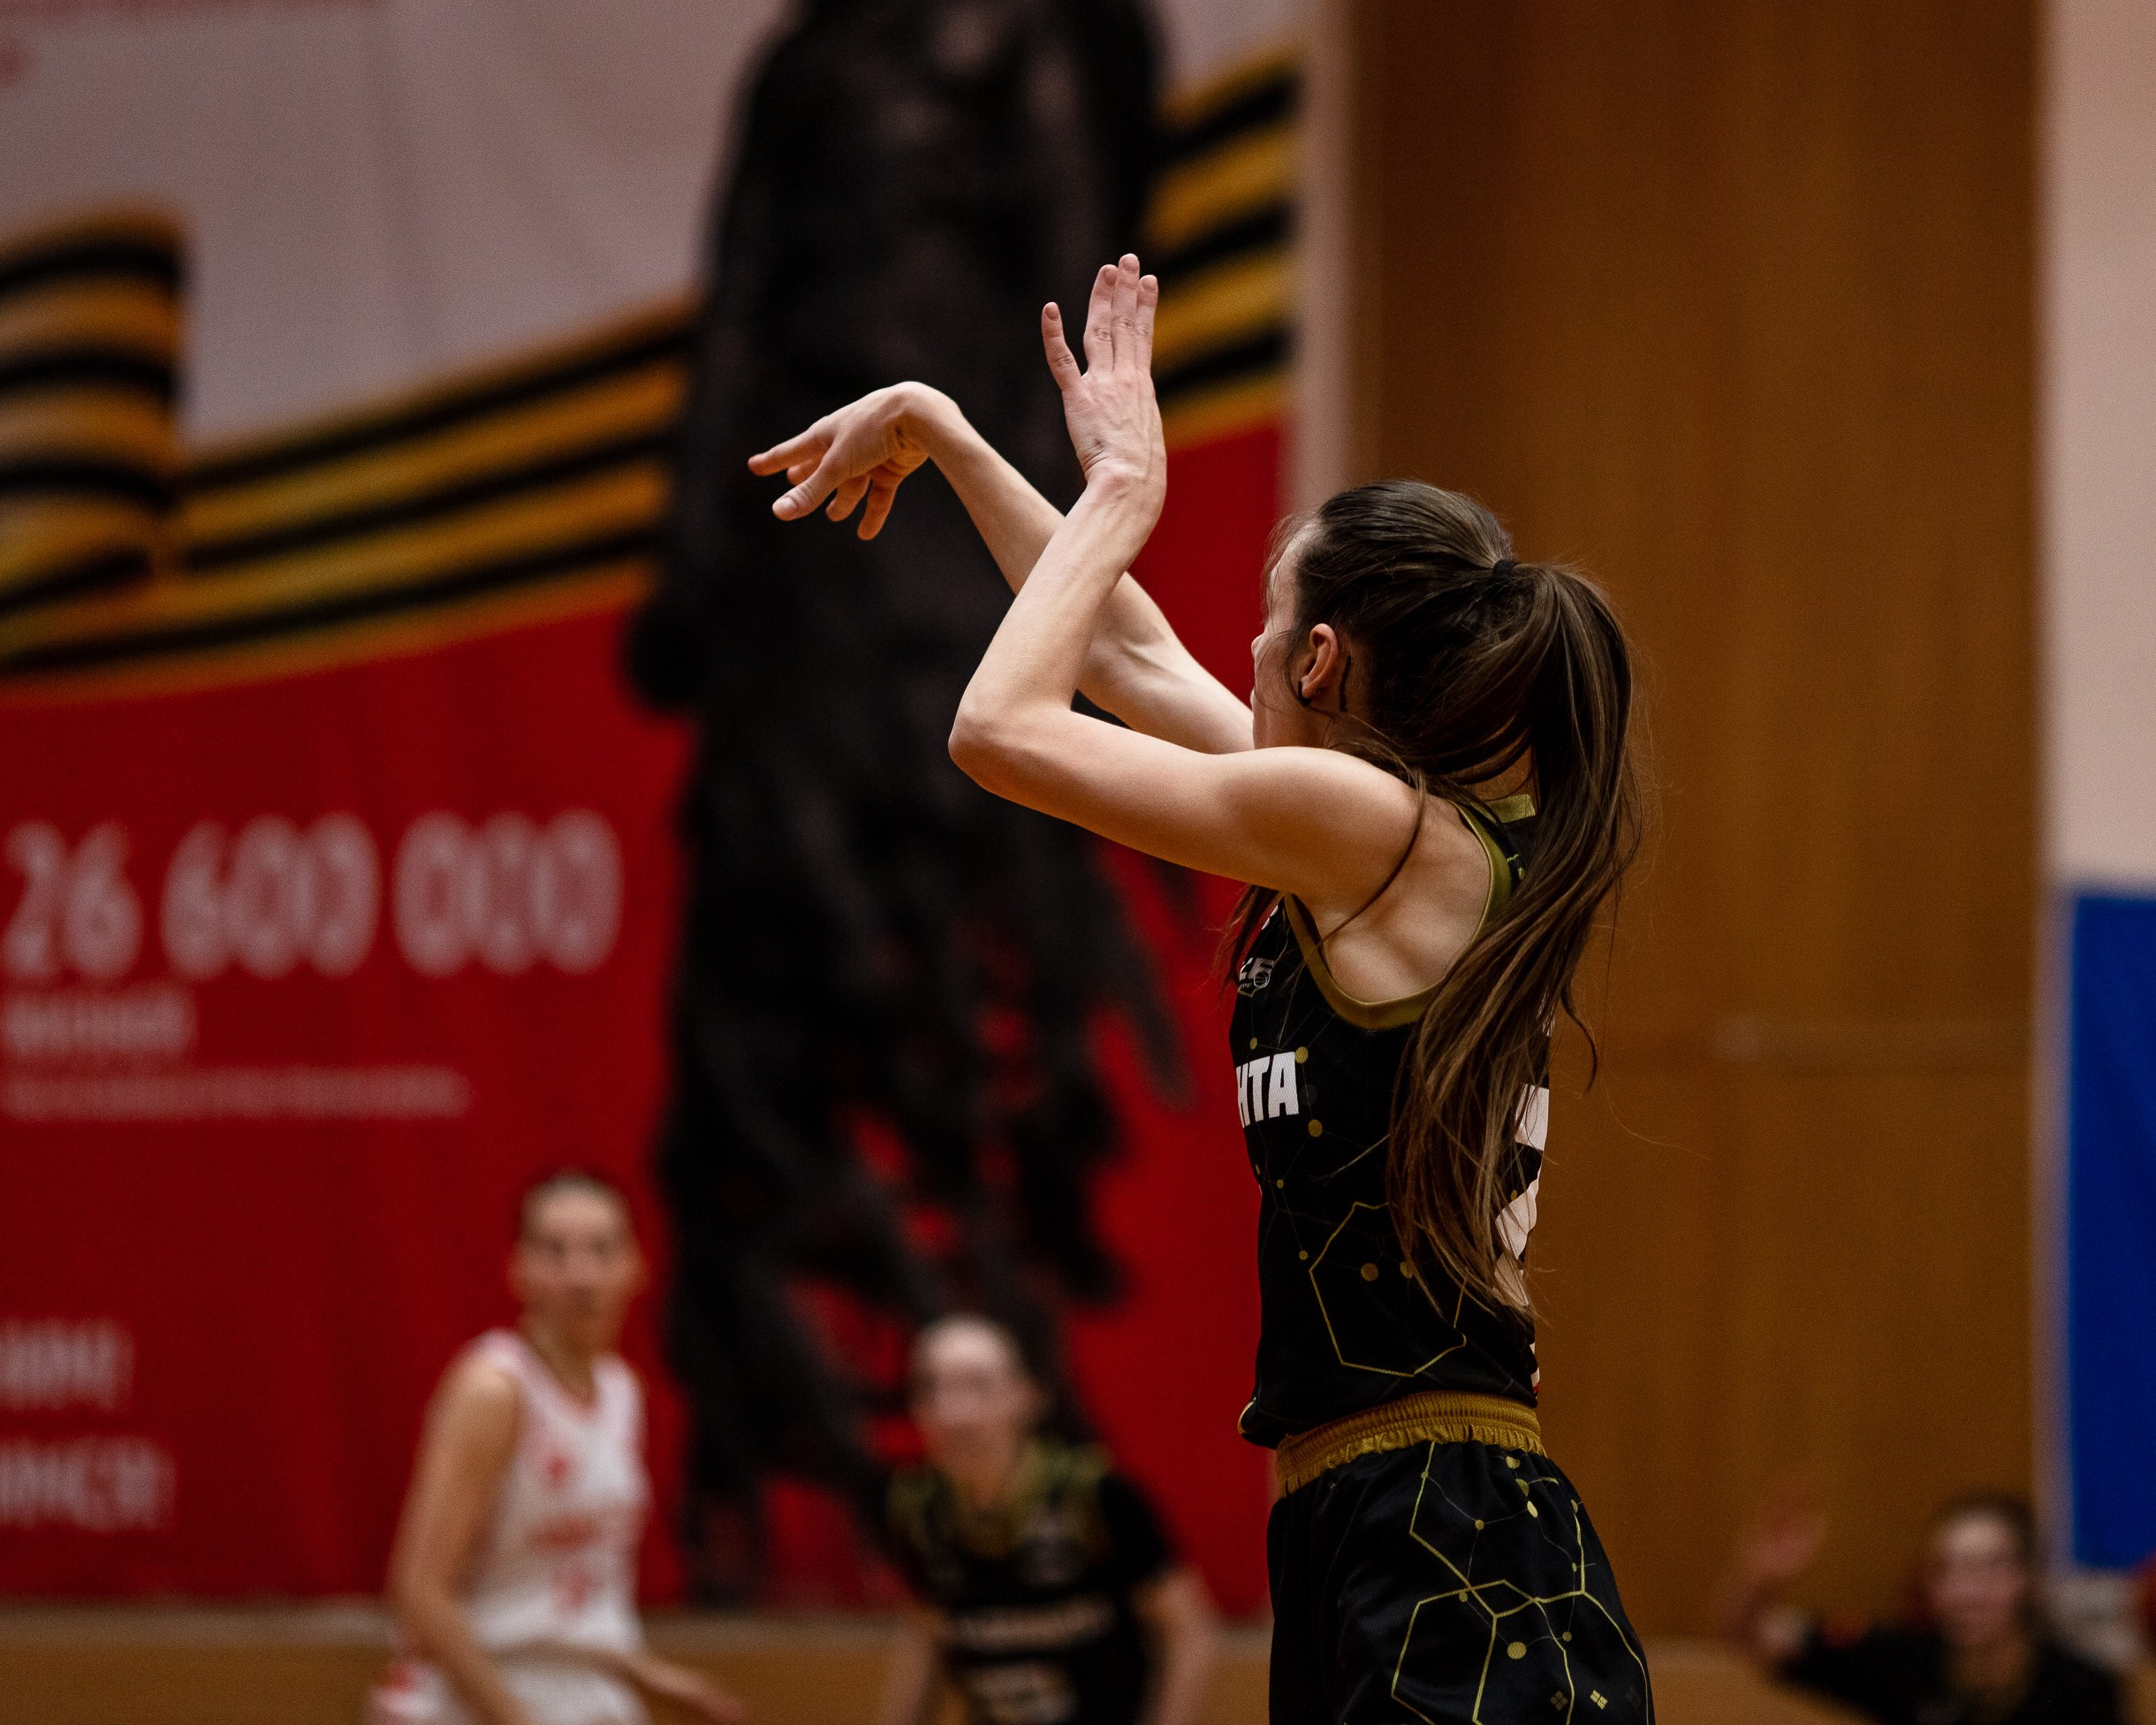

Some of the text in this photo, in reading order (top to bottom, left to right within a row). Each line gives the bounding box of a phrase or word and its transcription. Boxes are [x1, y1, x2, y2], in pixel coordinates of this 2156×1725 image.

[4, 808, 624, 979] 26 600 000
